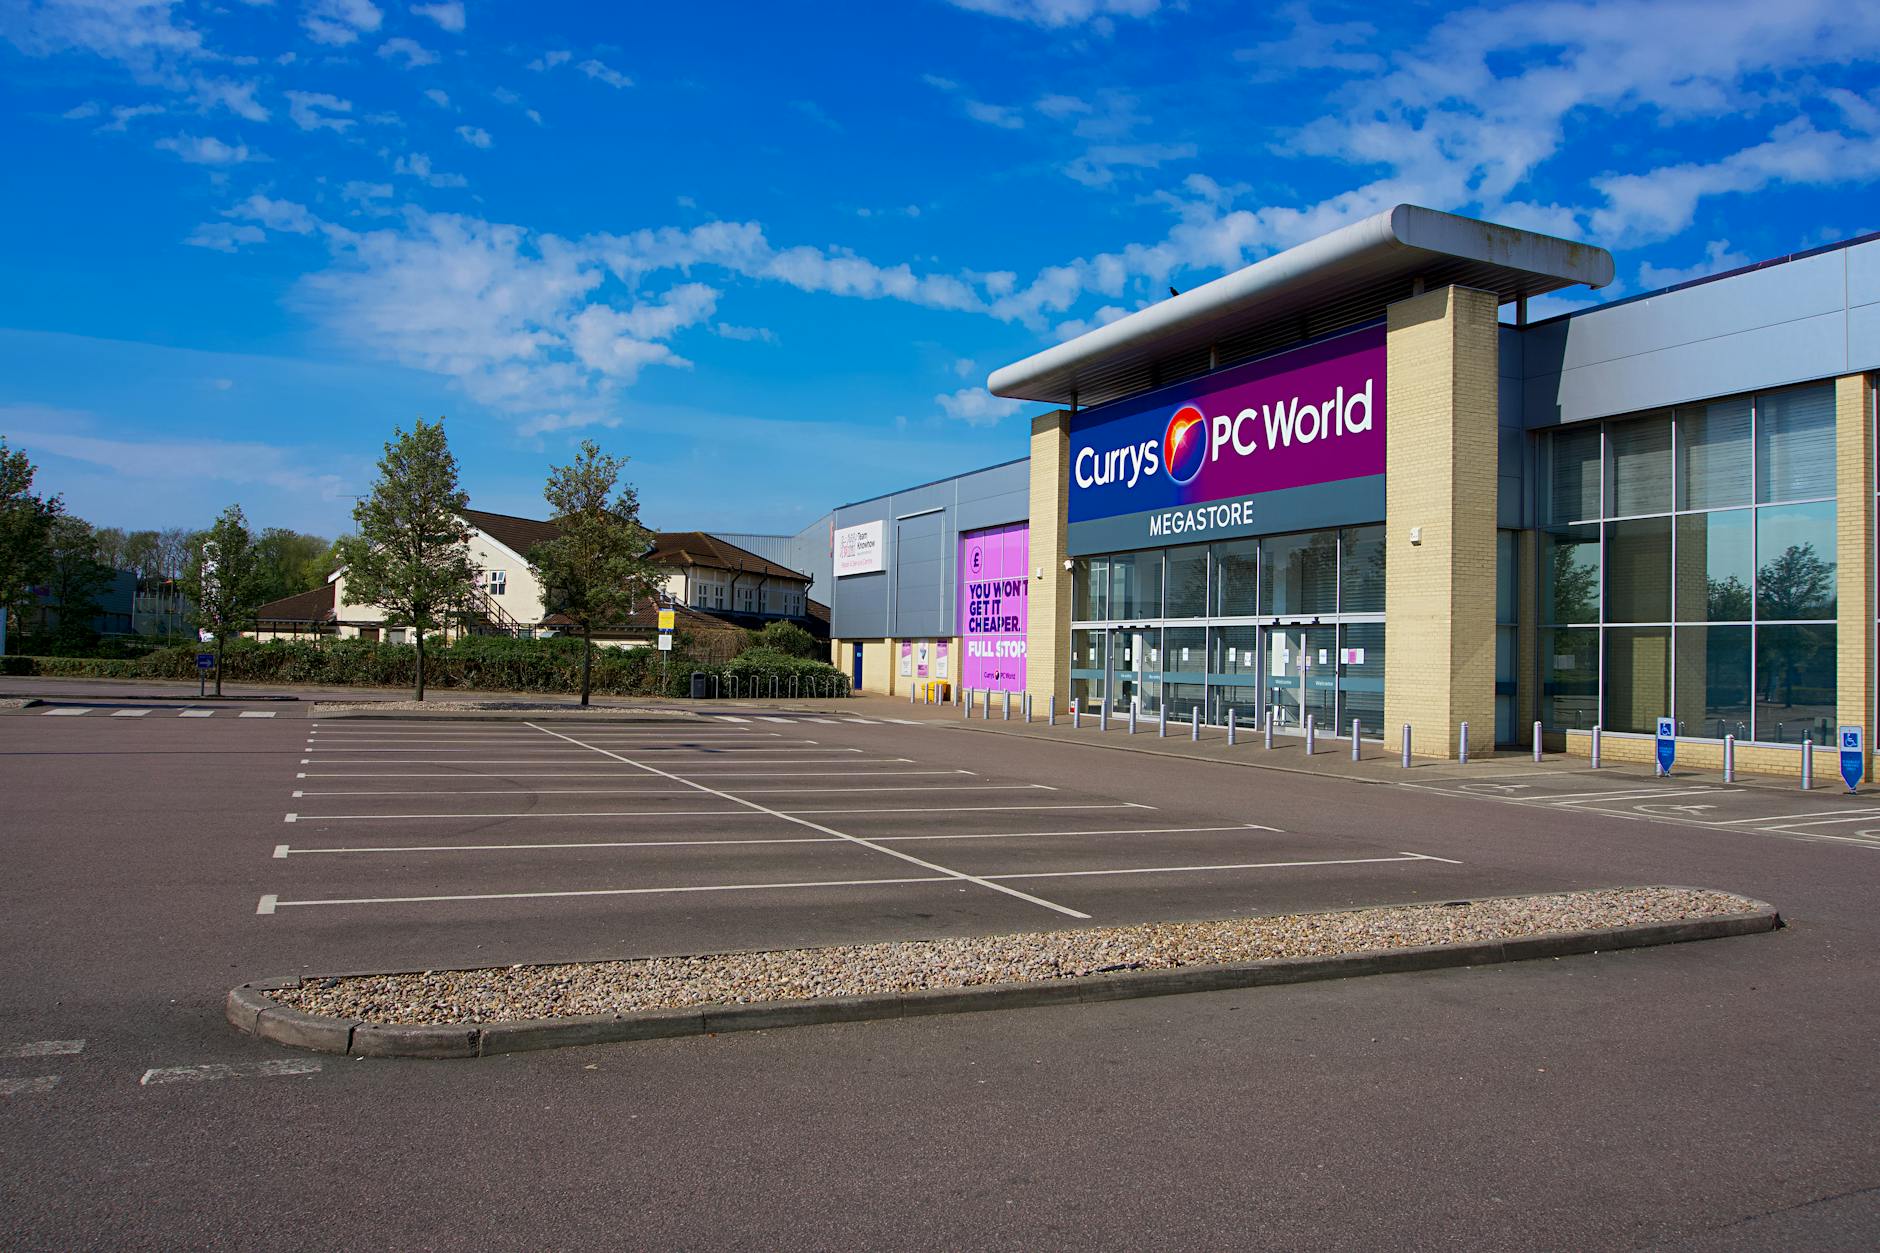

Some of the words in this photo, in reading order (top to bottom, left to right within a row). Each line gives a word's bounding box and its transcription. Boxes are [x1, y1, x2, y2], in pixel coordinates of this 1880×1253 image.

[1075, 439, 1159, 489] Currys
[1211, 407, 1258, 462] PC
[1262, 378, 1373, 450] World
[1149, 500, 1254, 537] MEGASTORE
[857, 532, 868, 541] Team
[969, 583, 991, 600] YOU
[969, 600, 990, 617] GET
[992, 599, 1001, 615] IT
[968, 616, 1021, 633] CHEAPER.
[968, 640, 995, 658] FULL
[995, 640, 1027, 658] STOP.
